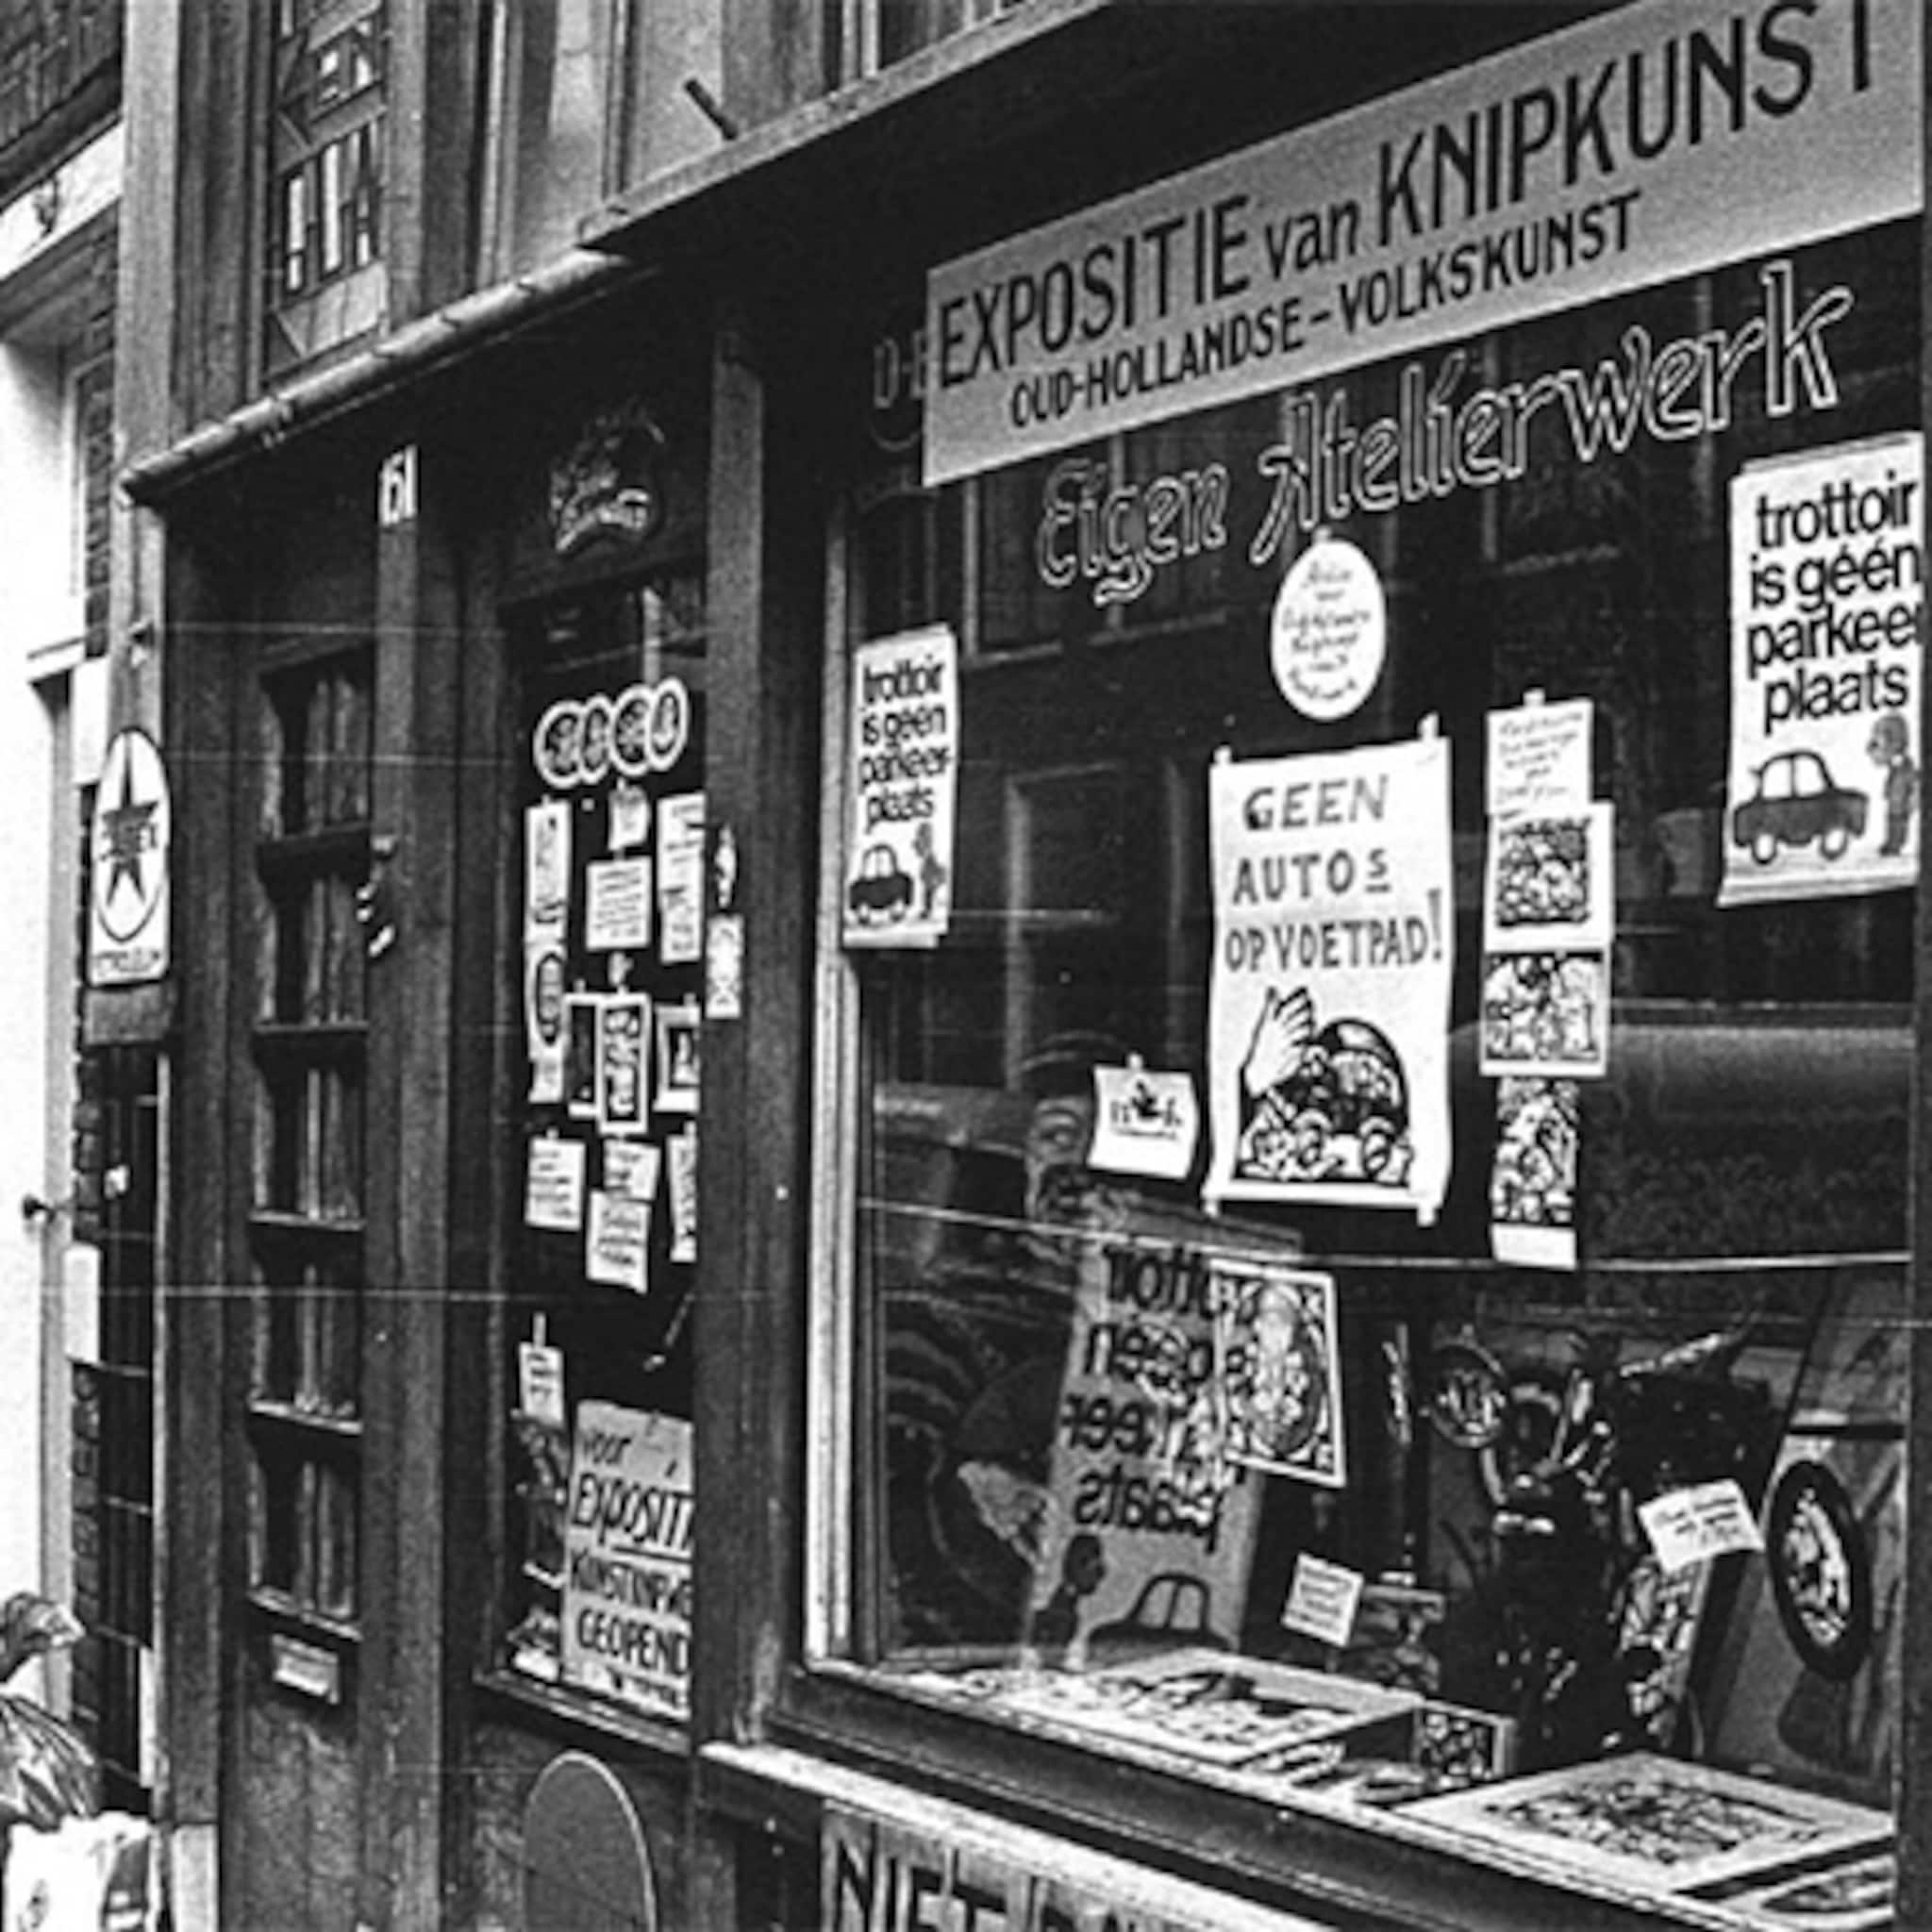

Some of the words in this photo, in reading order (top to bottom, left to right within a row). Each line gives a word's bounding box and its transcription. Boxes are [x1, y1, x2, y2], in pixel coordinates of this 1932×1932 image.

[940, 196, 1250, 388] EXPOSITIE
[1265, 200, 1359, 279] van
[1038, 459, 1227, 608] Eigen
[1756, 470, 1917, 548] trottoir
[1750, 553, 1786, 609] is
[1765, 659, 1908, 736] plaats
[1242, 773, 1389, 831] GEEN
[1225, 927, 1266, 973] OP
[1273, 887, 1442, 971] VOETPAD!
